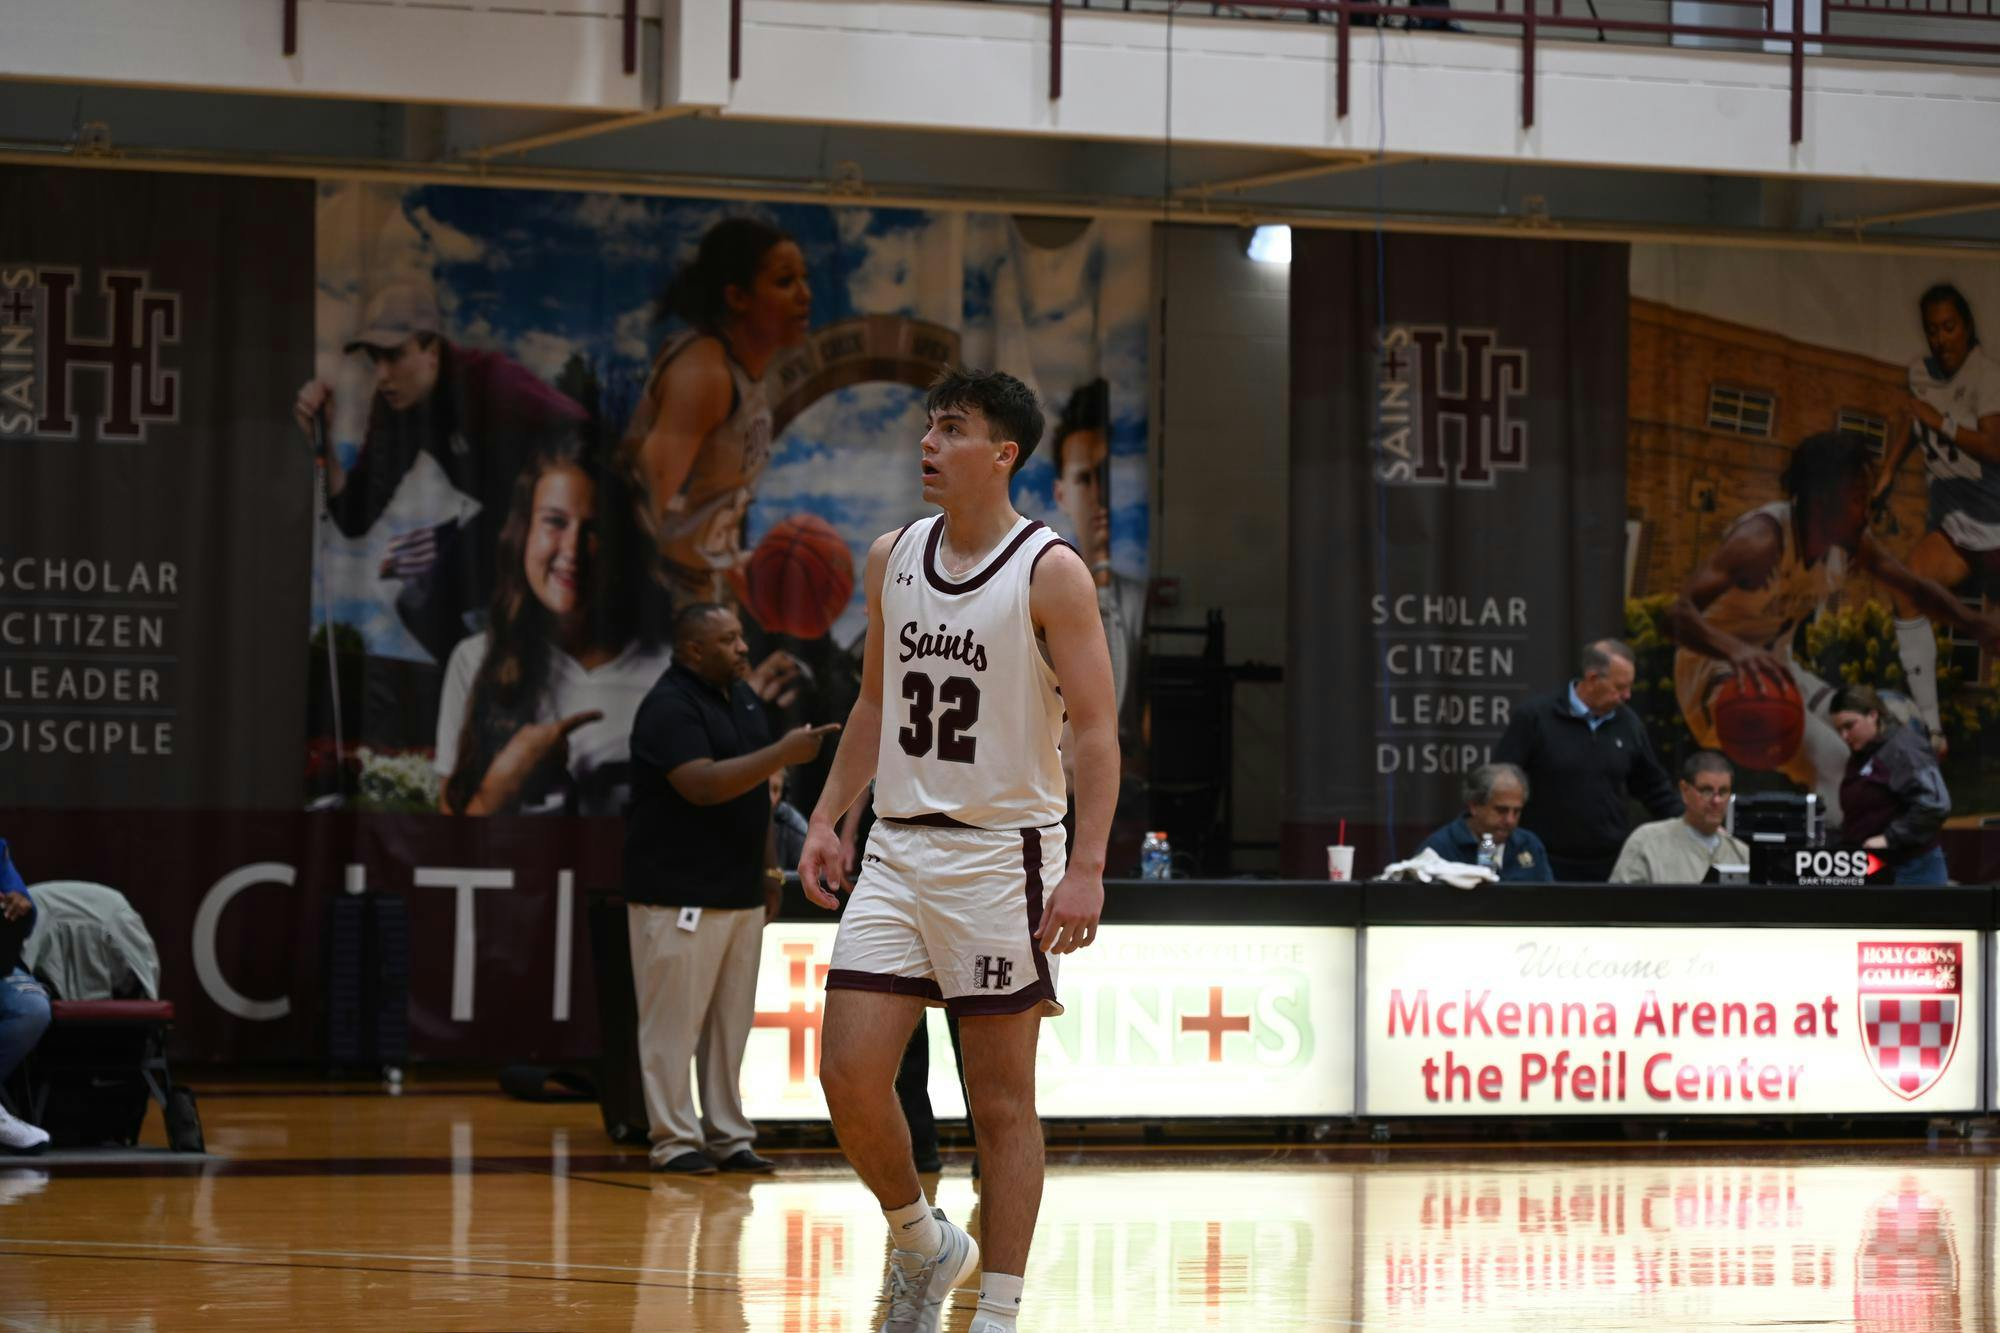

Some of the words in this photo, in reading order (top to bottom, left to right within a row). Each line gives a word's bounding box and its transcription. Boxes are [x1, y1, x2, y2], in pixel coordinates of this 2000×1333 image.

[0, 557, 178, 594] CHOLAR
[1371, 594, 1528, 627] SCHOLAR
[2, 611, 164, 648] CITIZEN
[899, 621, 988, 672] Saints
[1386, 643, 1514, 676] CITIZEN
[4, 665, 160, 702] LEADER
[898, 670, 981, 765] 32
[1390, 693, 1511, 726] LEADER
[1376, 742, 1492, 774] DISCIPL
[1796, 850, 1868, 877] POSS
[1515, 941, 1671, 979] Welcome
[1863, 946, 1904, 964] HOLY
[1905, 946, 1956, 964] CROSS
[1862, 968, 1936, 986] COLLEGE
[1387, 988, 1617, 1038] McKenna
[1634, 989, 1778, 1038] Arena
[1793, 994, 1839, 1038] at
[1421, 1051, 1502, 1103] the
[1520, 1049, 1627, 1103] Pfeil
[1643, 1052, 1805, 1102] Center
